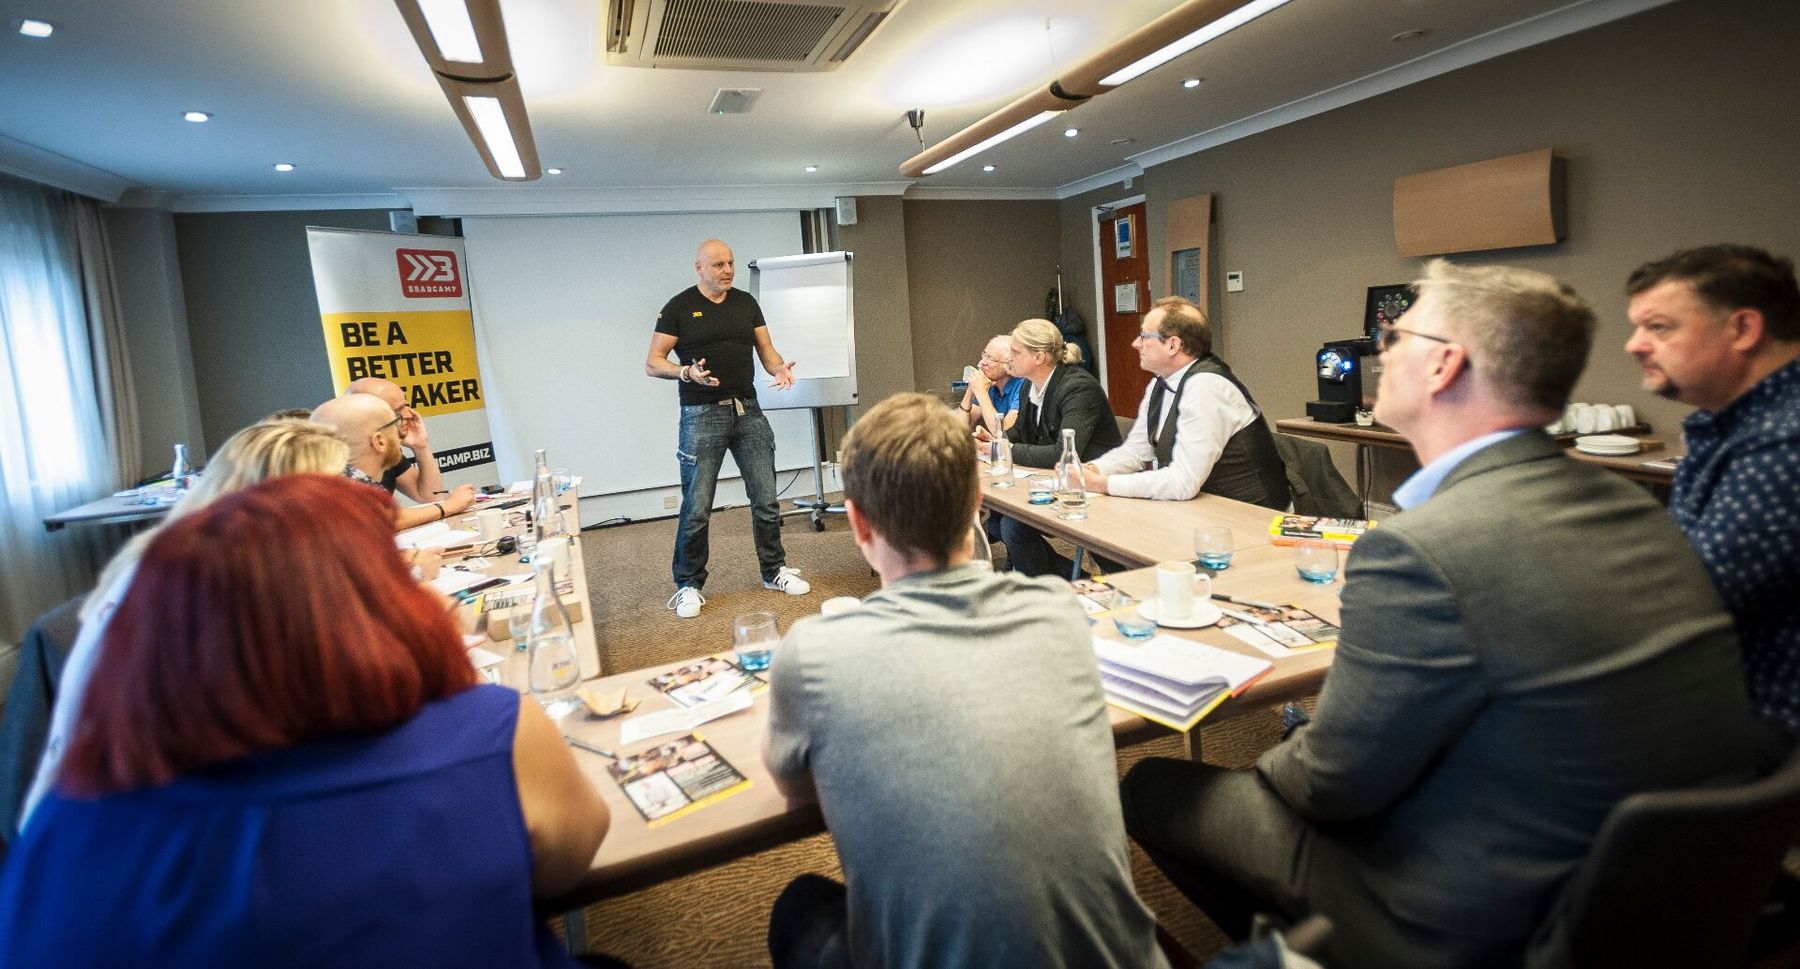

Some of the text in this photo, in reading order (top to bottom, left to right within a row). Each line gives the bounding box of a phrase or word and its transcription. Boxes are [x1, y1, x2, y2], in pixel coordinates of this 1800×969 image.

[408, 285, 457, 293] BRADCAMP
[340, 320, 408, 348] BE A
[347, 350, 454, 382] BETTER
[400, 378, 480, 409] AKER
[434, 447, 491, 468] CAMP.BIZ
